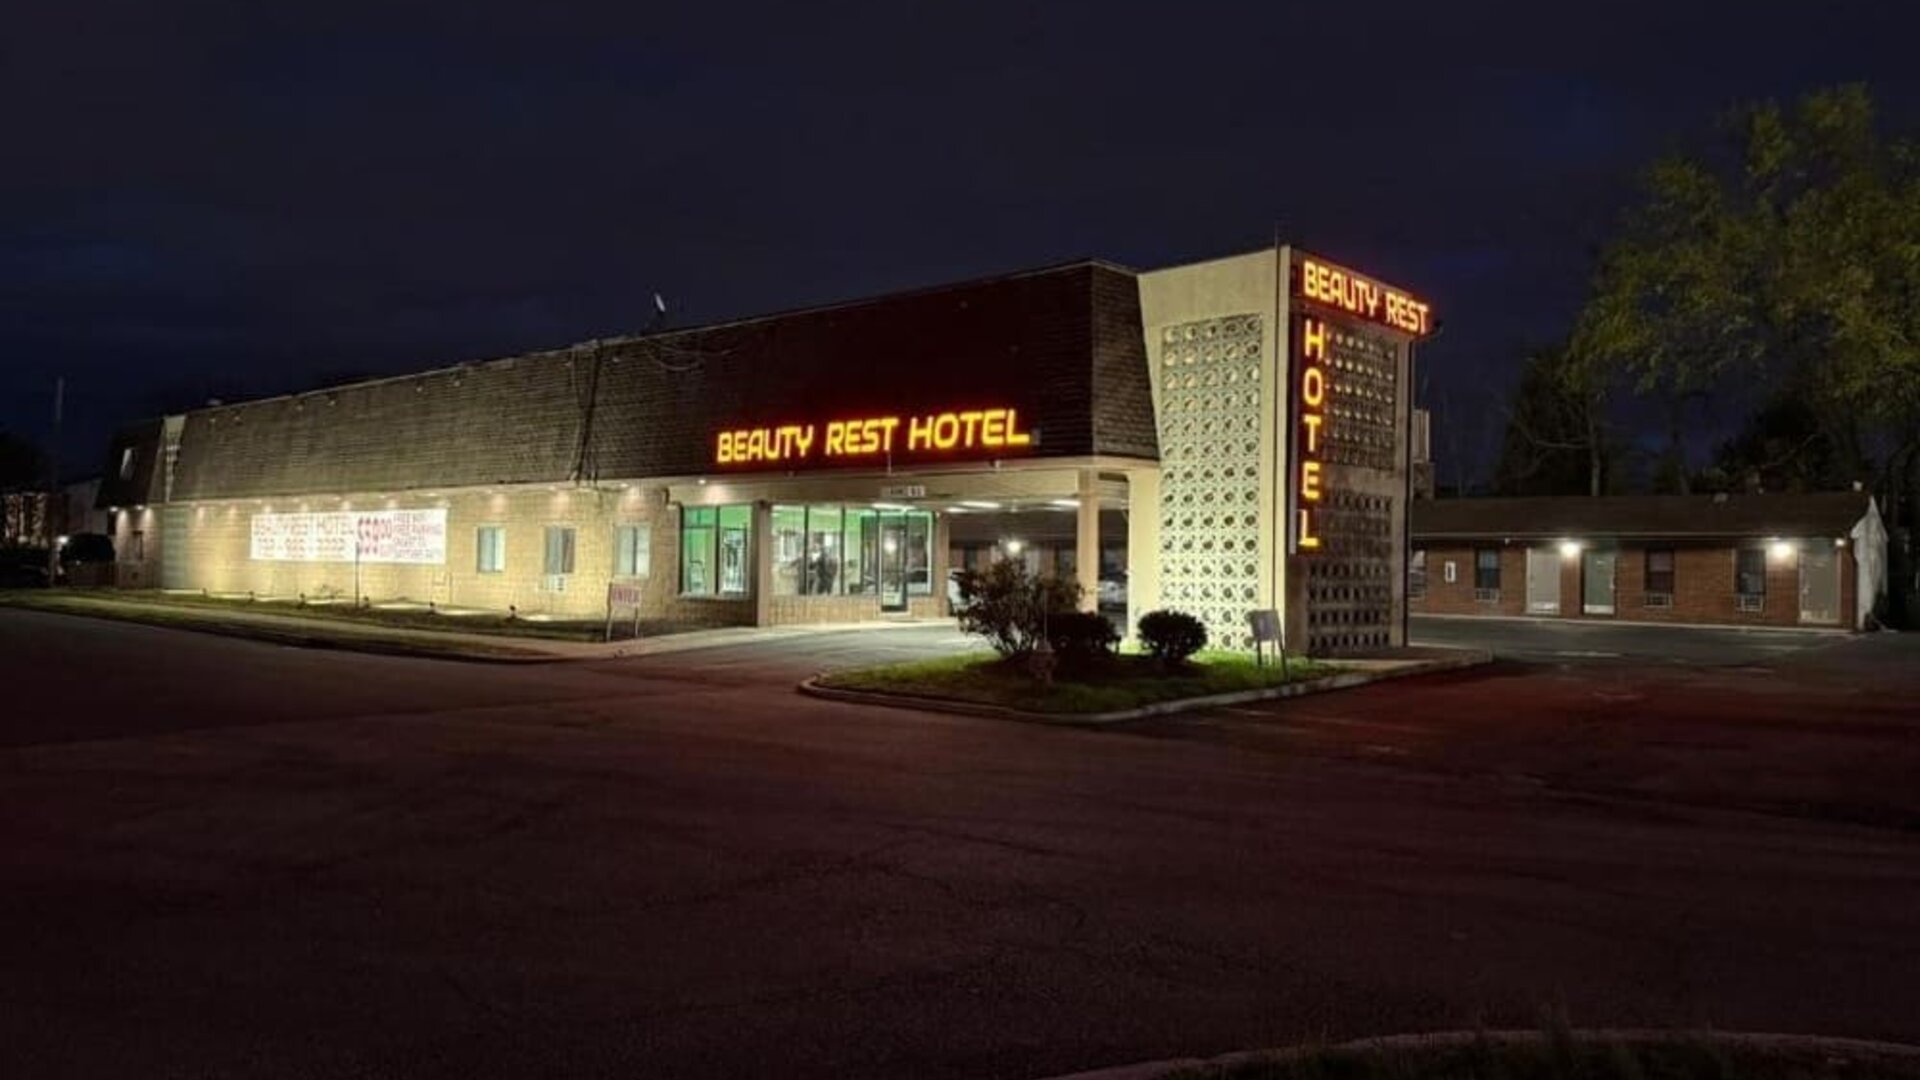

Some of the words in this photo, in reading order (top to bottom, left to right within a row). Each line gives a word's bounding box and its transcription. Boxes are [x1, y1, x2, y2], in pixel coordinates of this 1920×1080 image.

[1303, 260, 1378, 317] BEAUTY
[1385, 292, 1428, 333] REST
[716, 424, 814, 463] BEAUTY
[825, 417, 899, 455] REST
[907, 408, 1031, 451] HOTEL
[1298, 319, 1324, 547] HOTEL
